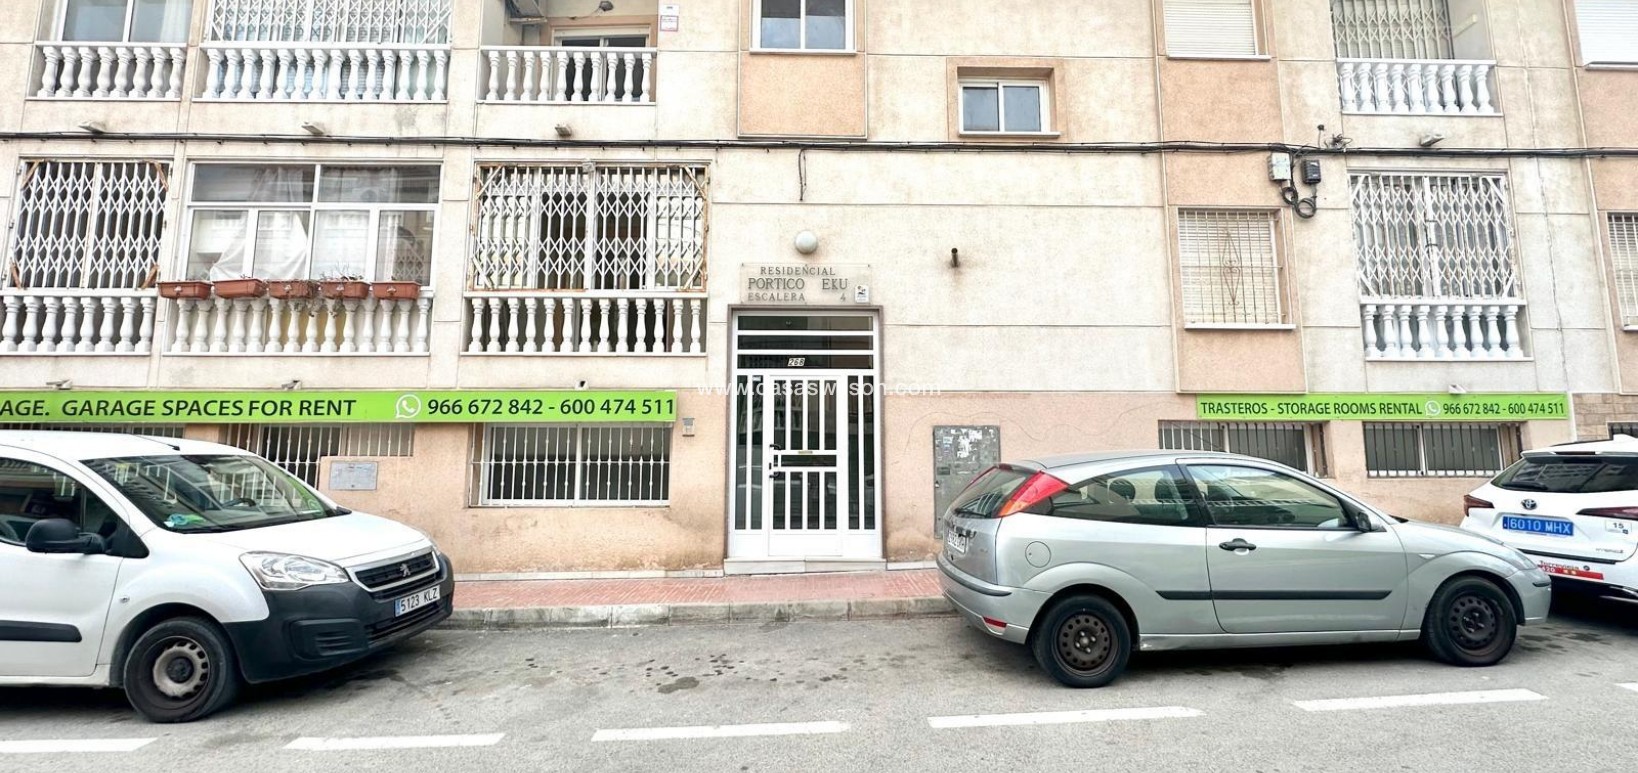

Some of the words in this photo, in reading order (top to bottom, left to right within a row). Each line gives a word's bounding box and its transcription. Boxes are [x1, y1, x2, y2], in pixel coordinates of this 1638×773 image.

[760, 266, 836, 276] RESIDENCIAL
[748, 278, 805, 290] PORTICO
[822, 278, 849, 290] EKU
[748, 293, 806, 302] ESCALERA
[840, 293, 847, 301] 4
[0, 400, 50, 416] AGE.
[62, 400, 156, 416] GARAGE
[161, 400, 244, 416] SPACES
[248, 400, 293, 416] FOR
[299, 400, 357, 416] RENT
[427, 399, 463, 415] 966
[468, 399, 503, 415] 672
[508, 399, 543, 415] 842
[560, 399, 595, 415] 600
[600, 399, 636, 415] 474
[642, 399, 673, 415] 511
[1200, 402, 1268, 414] TRASTEROS
[1277, 402, 1330, 415] STORAGE
[1333, 402, 1377, 414] ROOMS
[1380, 402, 1422, 415] RENTAL
[1443, 403, 1461, 414] 966
[1463, 403, 1481, 415] 672
[1483, 403, 1500, 415] 842
[1508, 403, 1526, 415] 600
[1528, 403, 1547, 415] 474
[1549, 403, 1565, 415] 511
[1510, 518, 1541, 531] 6010
[1545, 521, 1571, 534] MHX
[400, 594, 420, 612] 5123
[423, 588, 438, 603] KLZ
